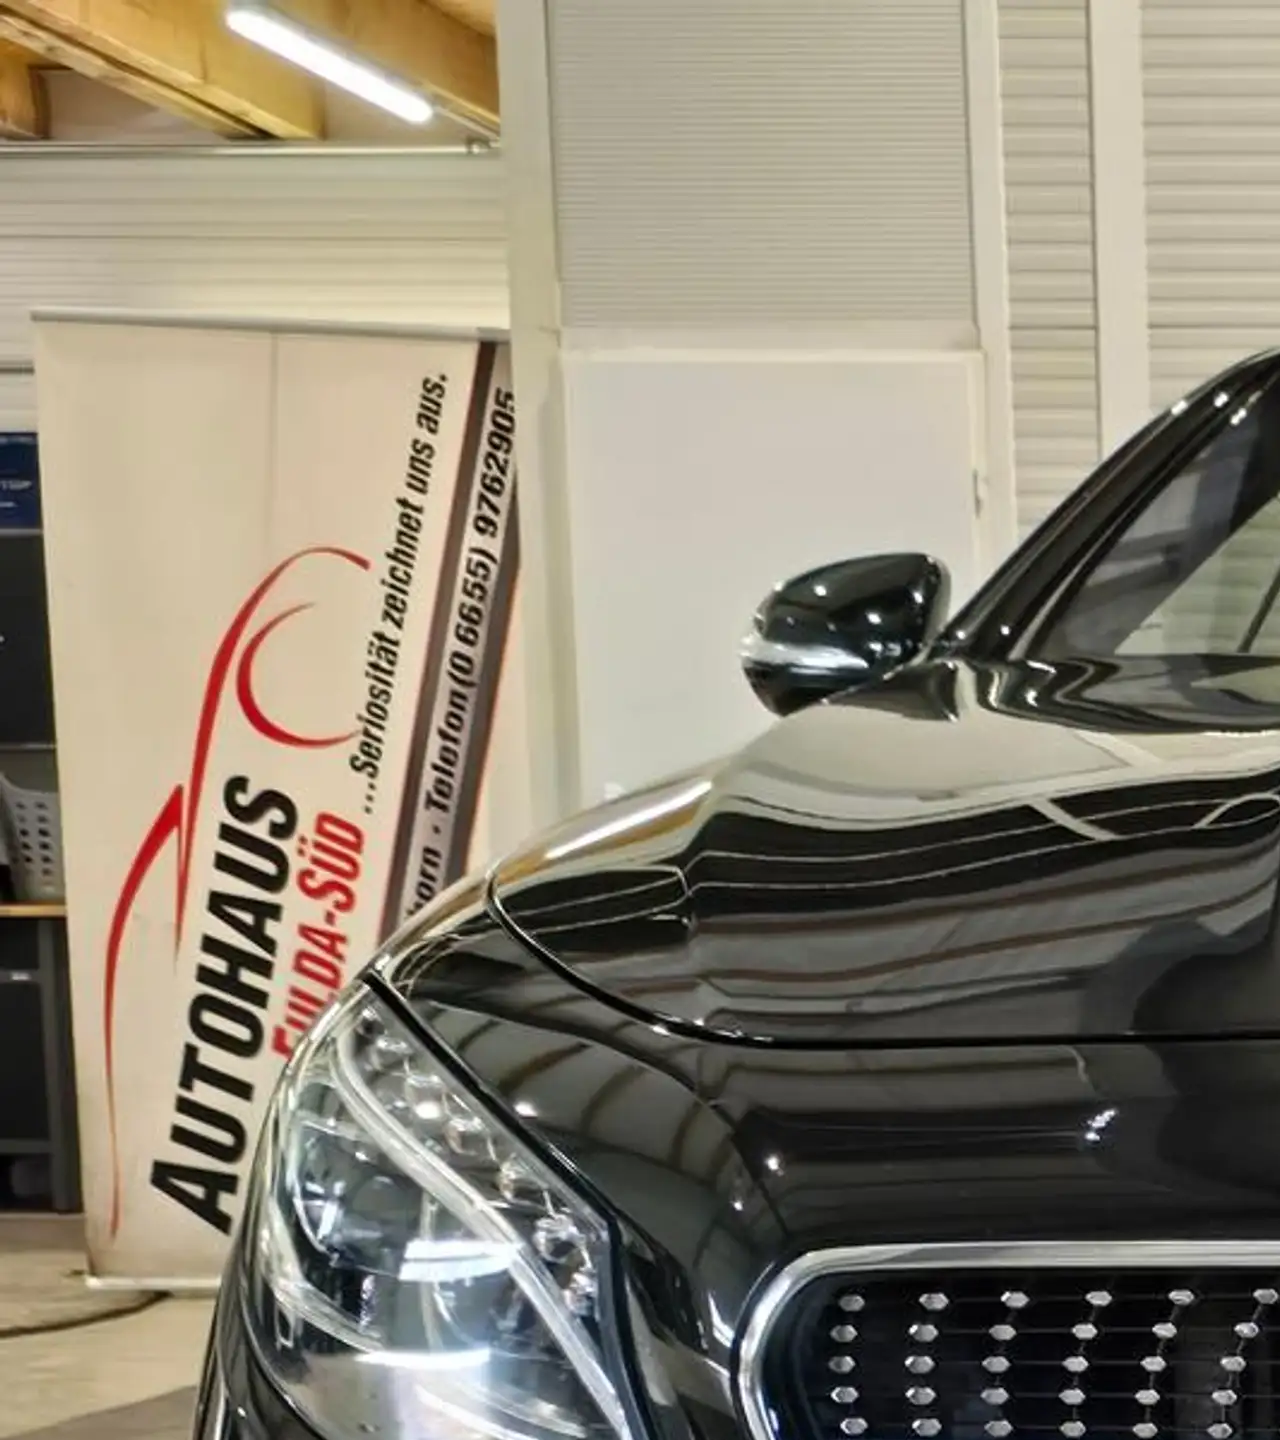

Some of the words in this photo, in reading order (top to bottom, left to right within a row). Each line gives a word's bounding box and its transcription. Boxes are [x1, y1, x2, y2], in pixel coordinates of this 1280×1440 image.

[405, 438, 436, 495] uns
[416, 374, 448, 435] aus.
[379, 497, 424, 630] zeichnet
[349, 631, 401, 815] ...Seriosität
[150, 775, 298, 1235] AUTOHAUS
